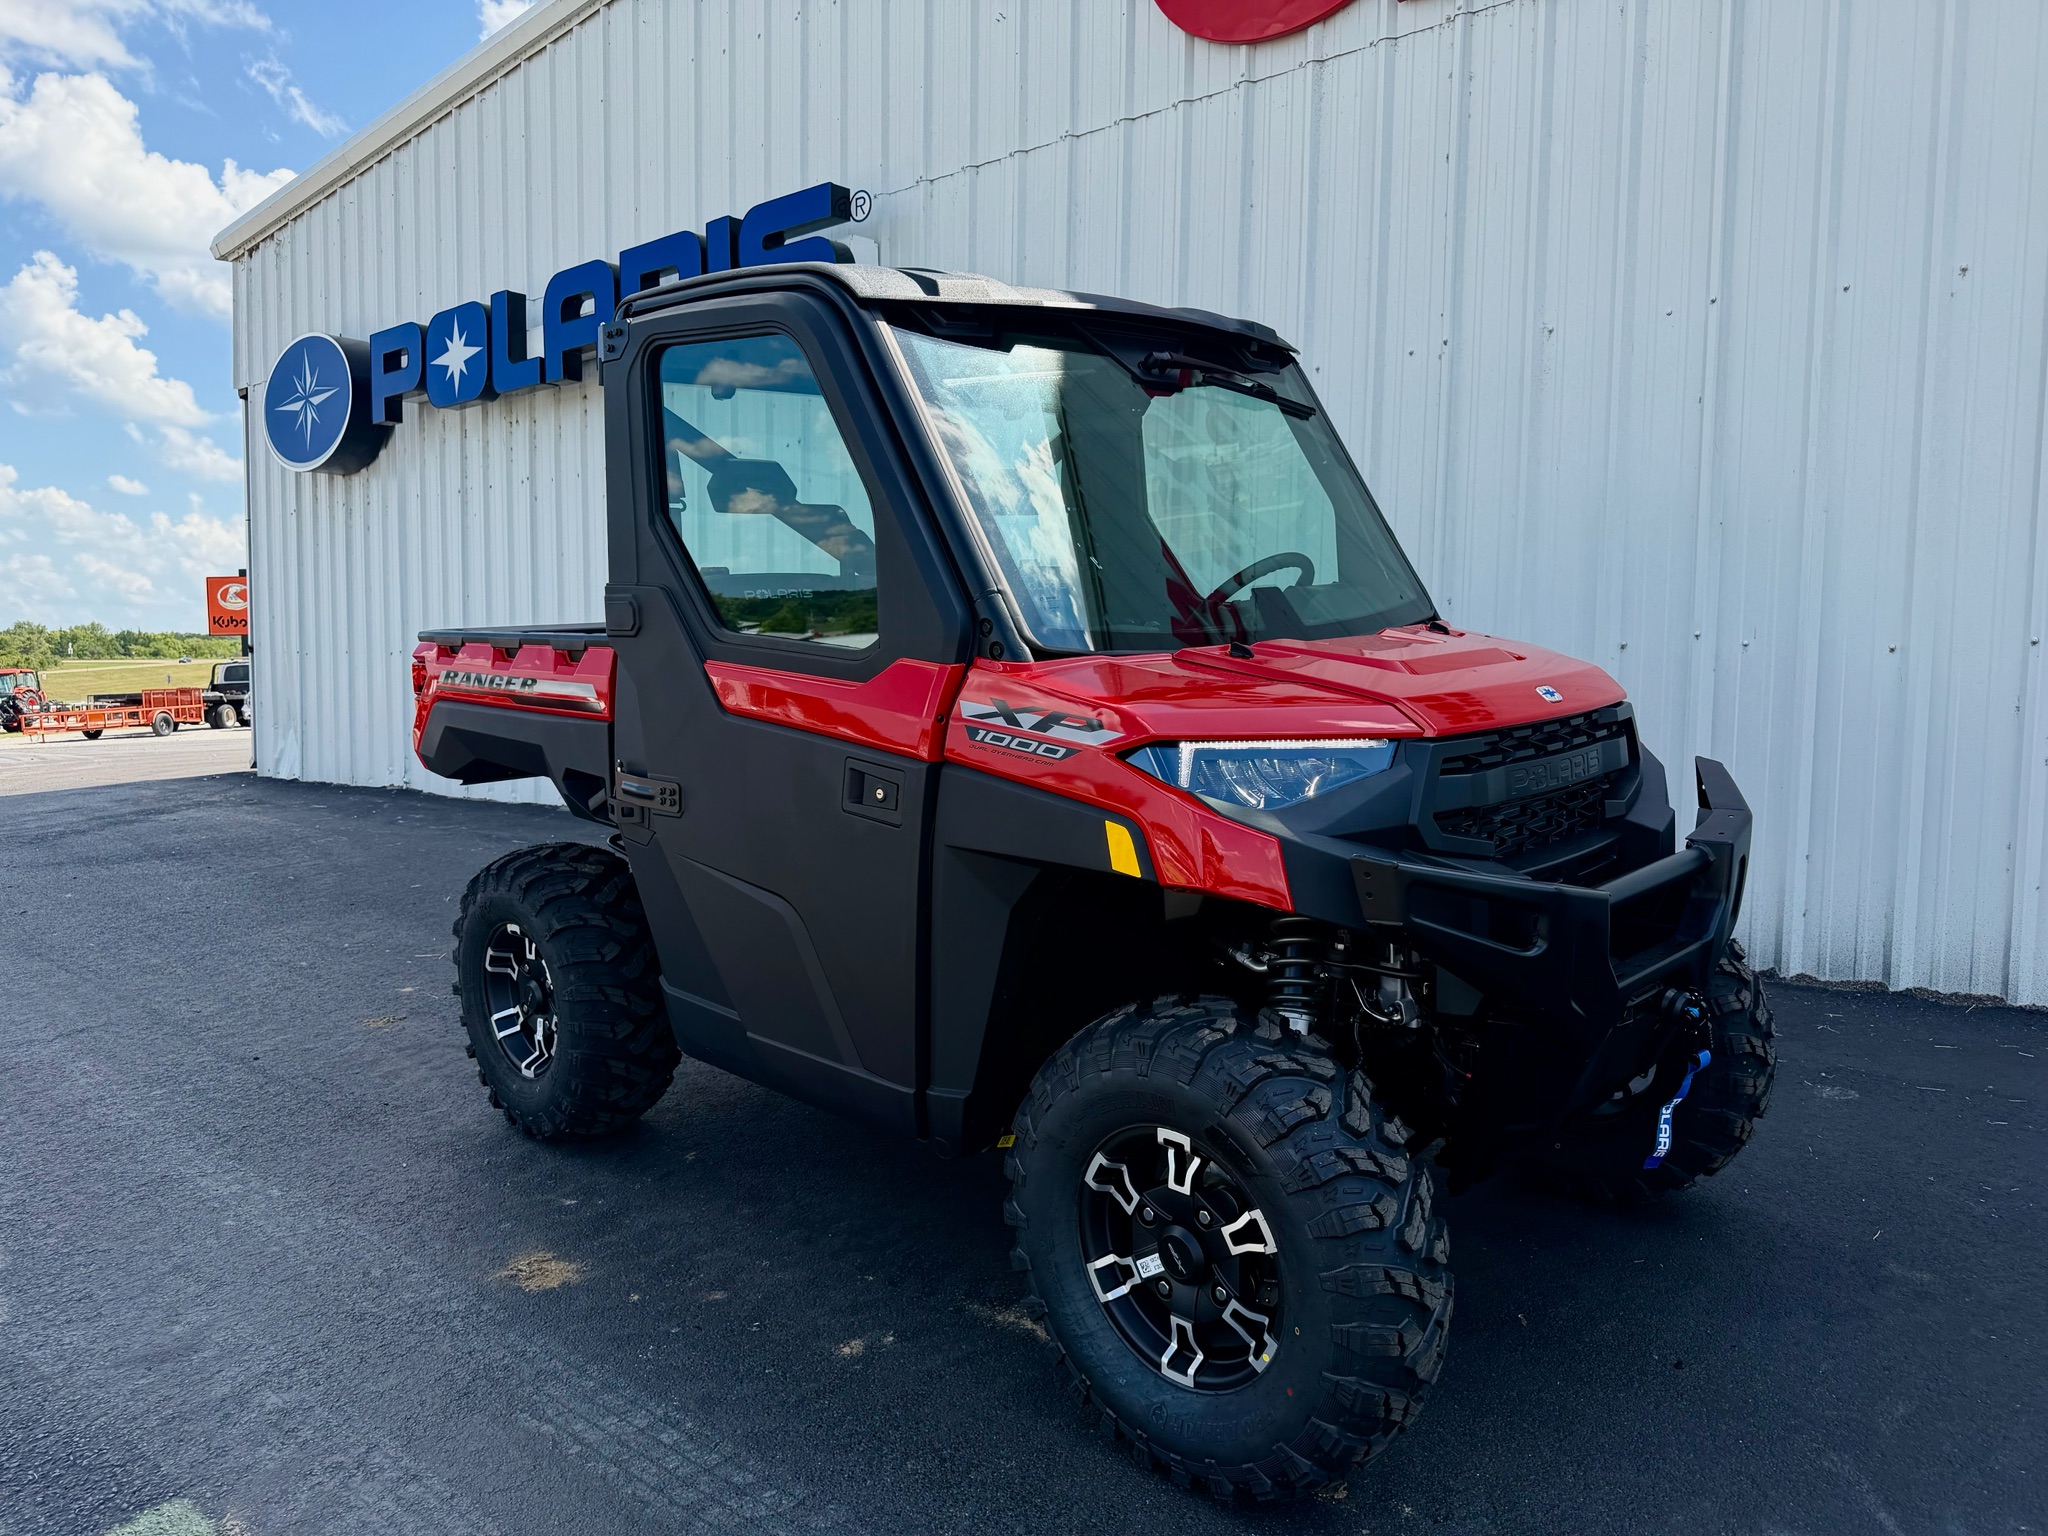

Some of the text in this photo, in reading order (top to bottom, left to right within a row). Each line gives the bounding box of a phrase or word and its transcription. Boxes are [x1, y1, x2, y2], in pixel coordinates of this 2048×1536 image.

[744, 588, 813, 600] POLARIS
[443, 670, 538, 694] RANGER
[965, 697, 1104, 733] XP
[968, 744, 1055, 767] DUAL OVERHEAD CAM
[974, 729, 1067, 759] 1000
[1511, 750, 1600, 790] POLARIS
[1653, 1098, 1683, 1158] POLARIS
